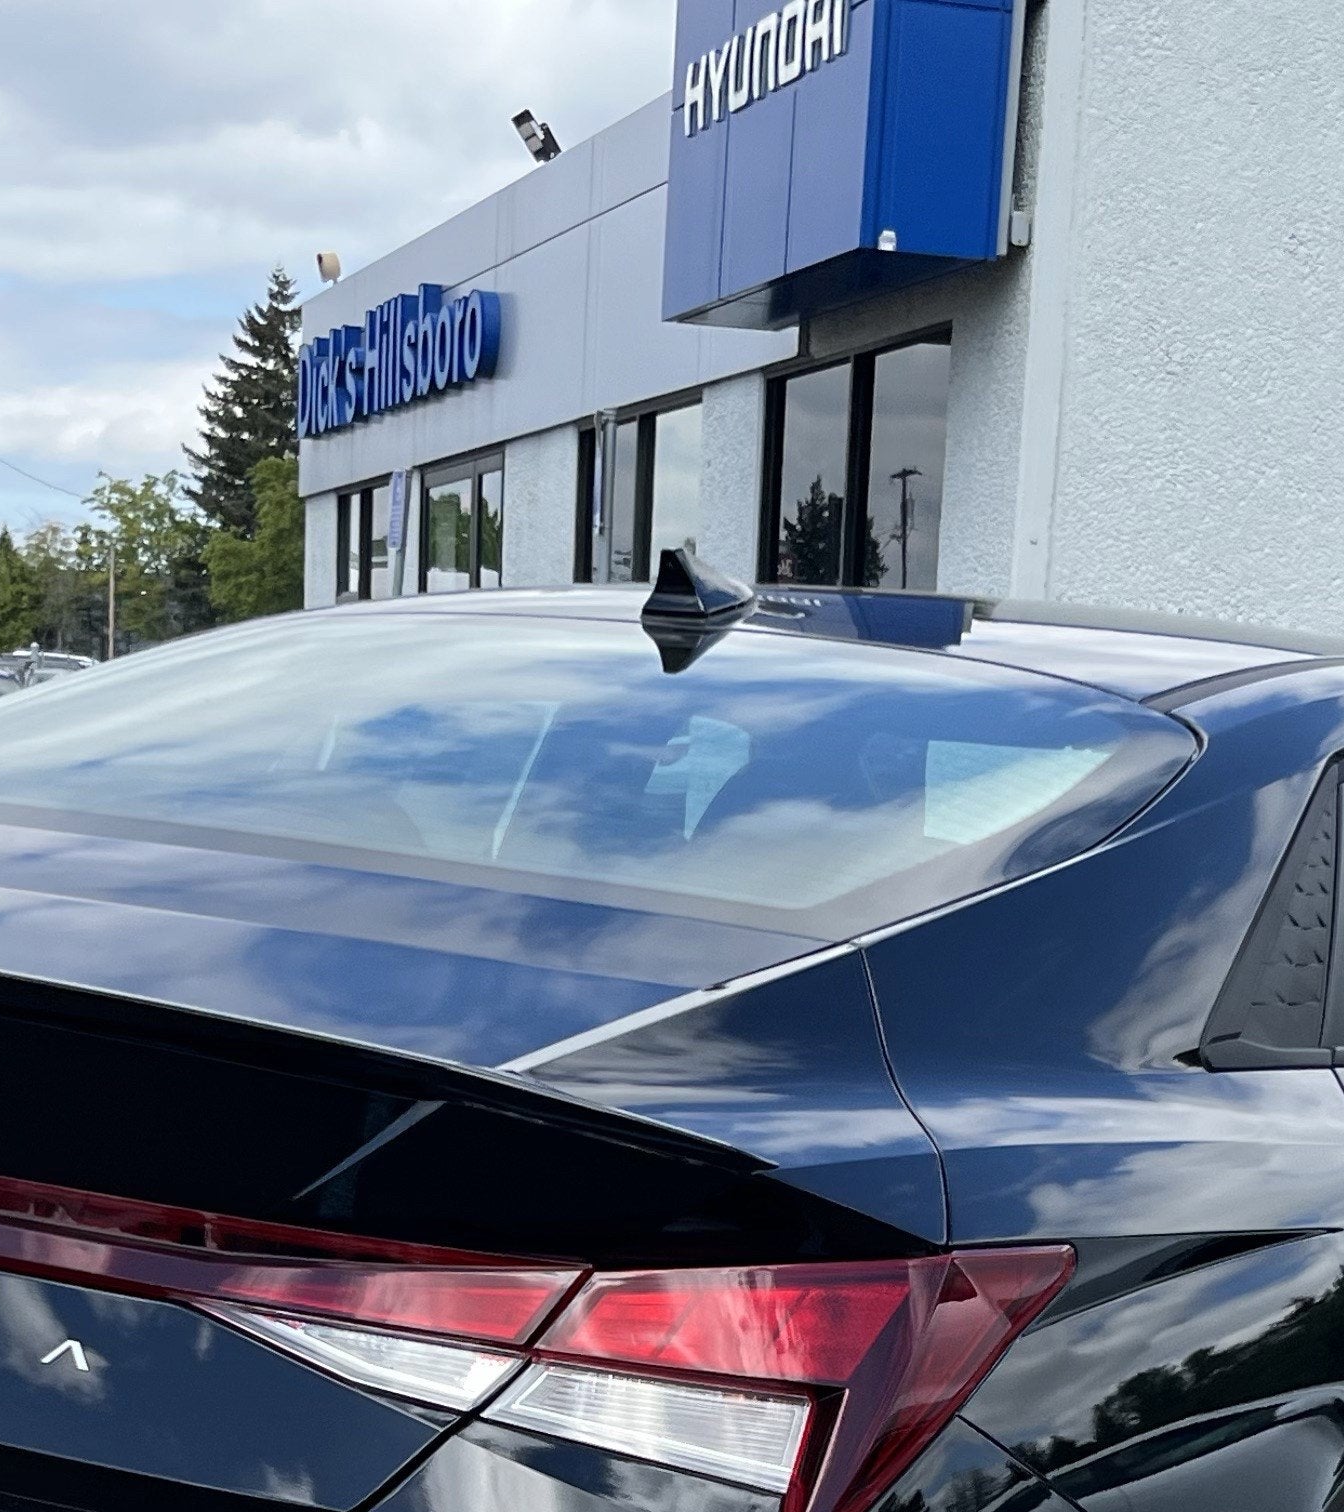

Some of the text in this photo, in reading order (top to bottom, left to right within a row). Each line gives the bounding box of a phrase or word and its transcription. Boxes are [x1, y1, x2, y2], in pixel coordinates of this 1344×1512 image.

[684, 0, 845, 138] HYUNDAI
[297, 283, 485, 439] Dick's Hillsboro
